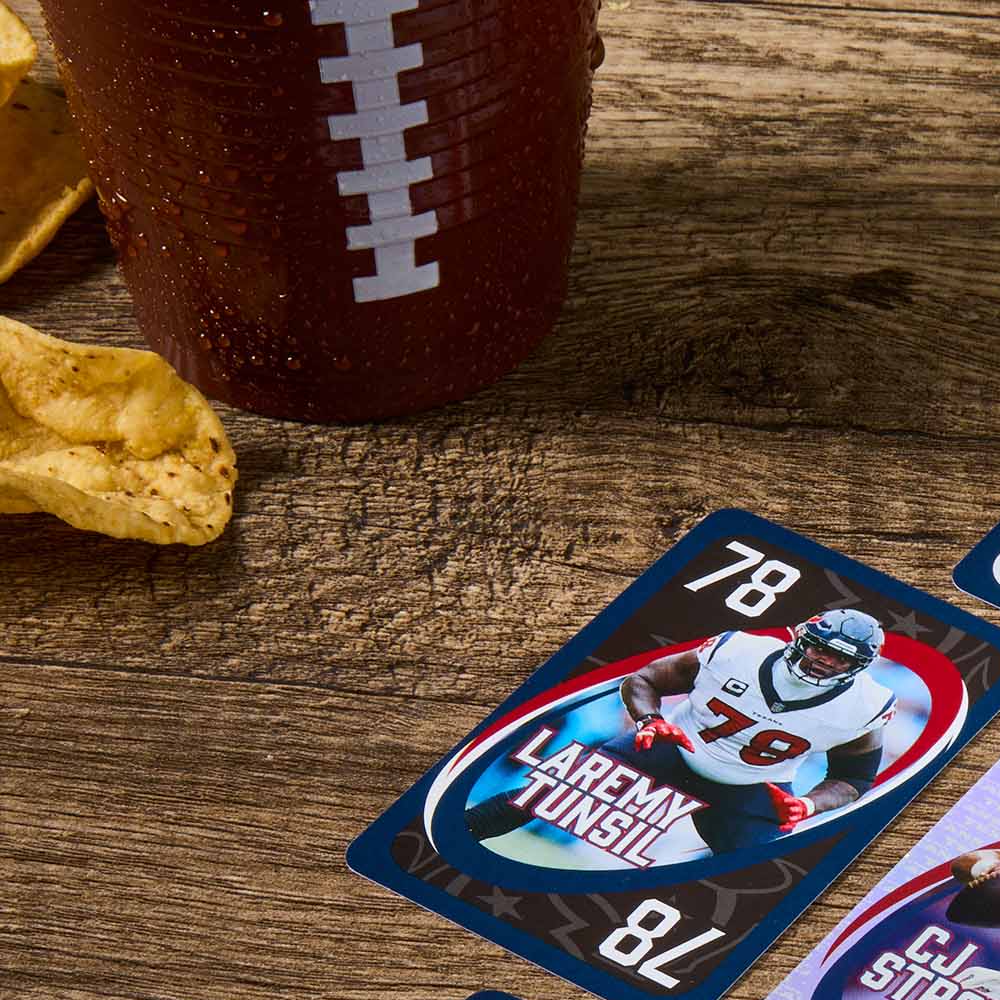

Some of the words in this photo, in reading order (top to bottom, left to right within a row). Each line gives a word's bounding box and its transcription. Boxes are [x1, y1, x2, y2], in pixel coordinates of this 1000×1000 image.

[683, 539, 802, 618] 78
[698, 697, 811, 766] 78
[514, 727, 708, 832] LAREMY
[521, 767, 669, 870] TUNSIL
[599, 897, 727, 989] 78
[903, 923, 978, 979] CJ
